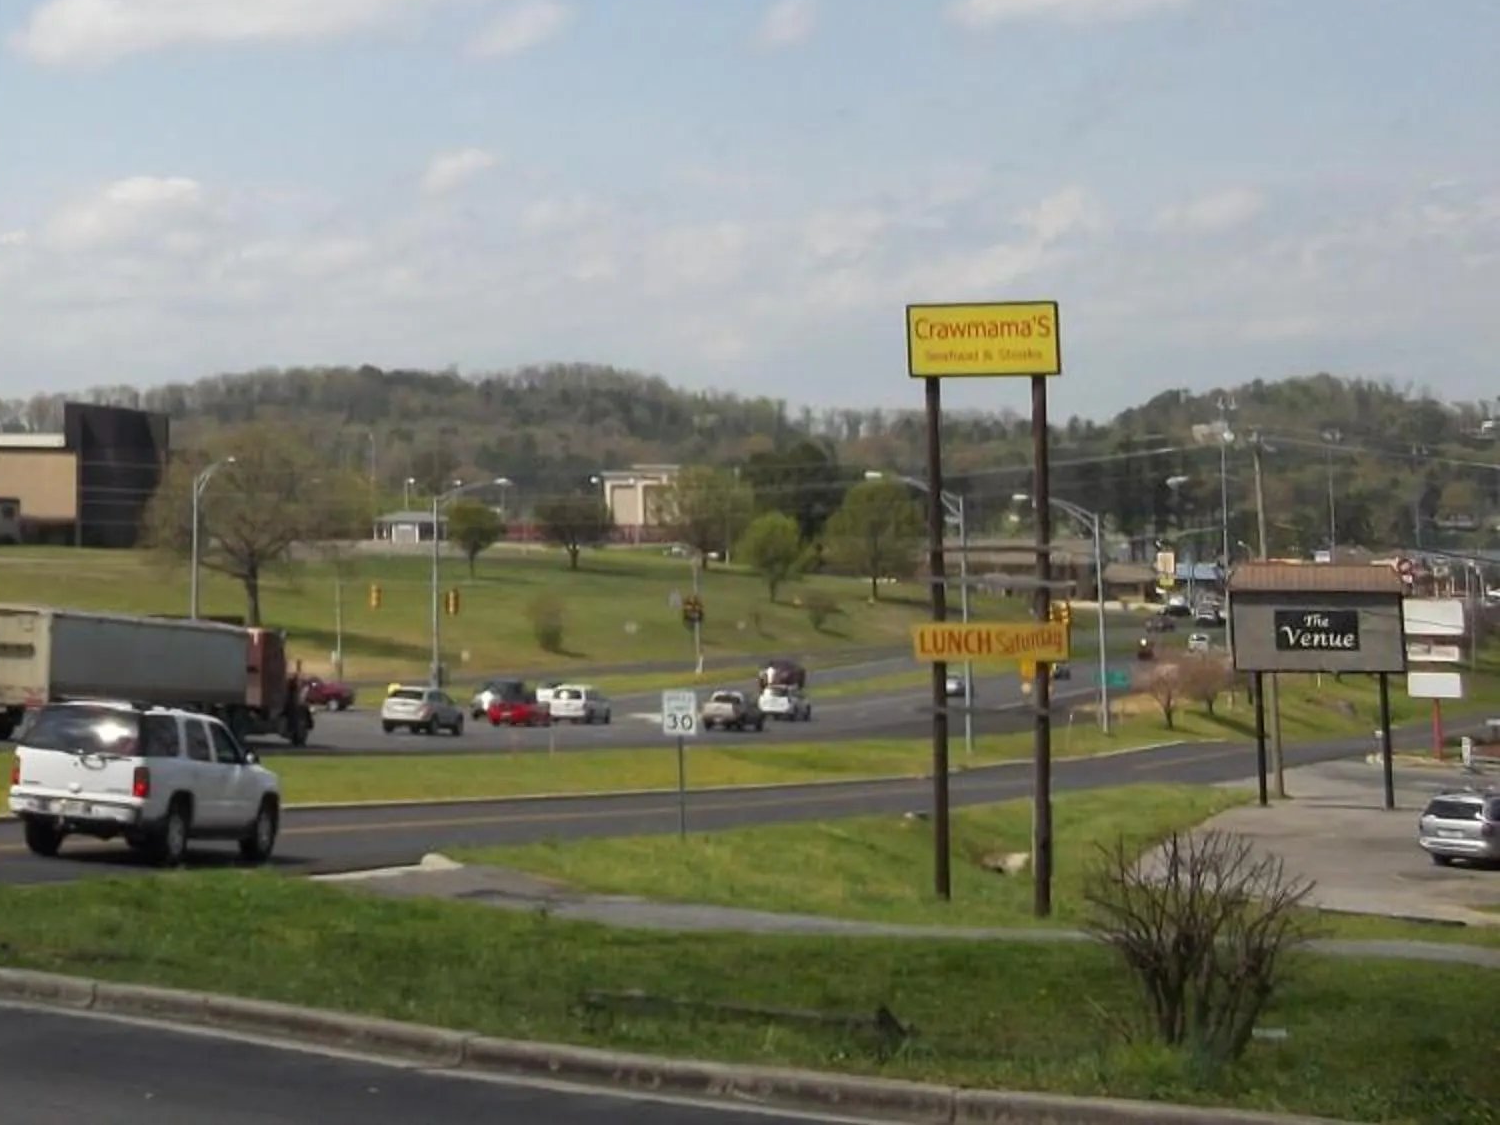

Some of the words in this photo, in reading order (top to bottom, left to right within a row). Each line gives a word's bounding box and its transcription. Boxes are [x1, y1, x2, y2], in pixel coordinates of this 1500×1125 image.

[915, 315, 1052, 340] Crawmama'S
[1303, 613, 1329, 627] The
[919, 629, 991, 655] LUNCH
[1281, 626, 1356, 648] Venue
[667, 714, 693, 731] 30
